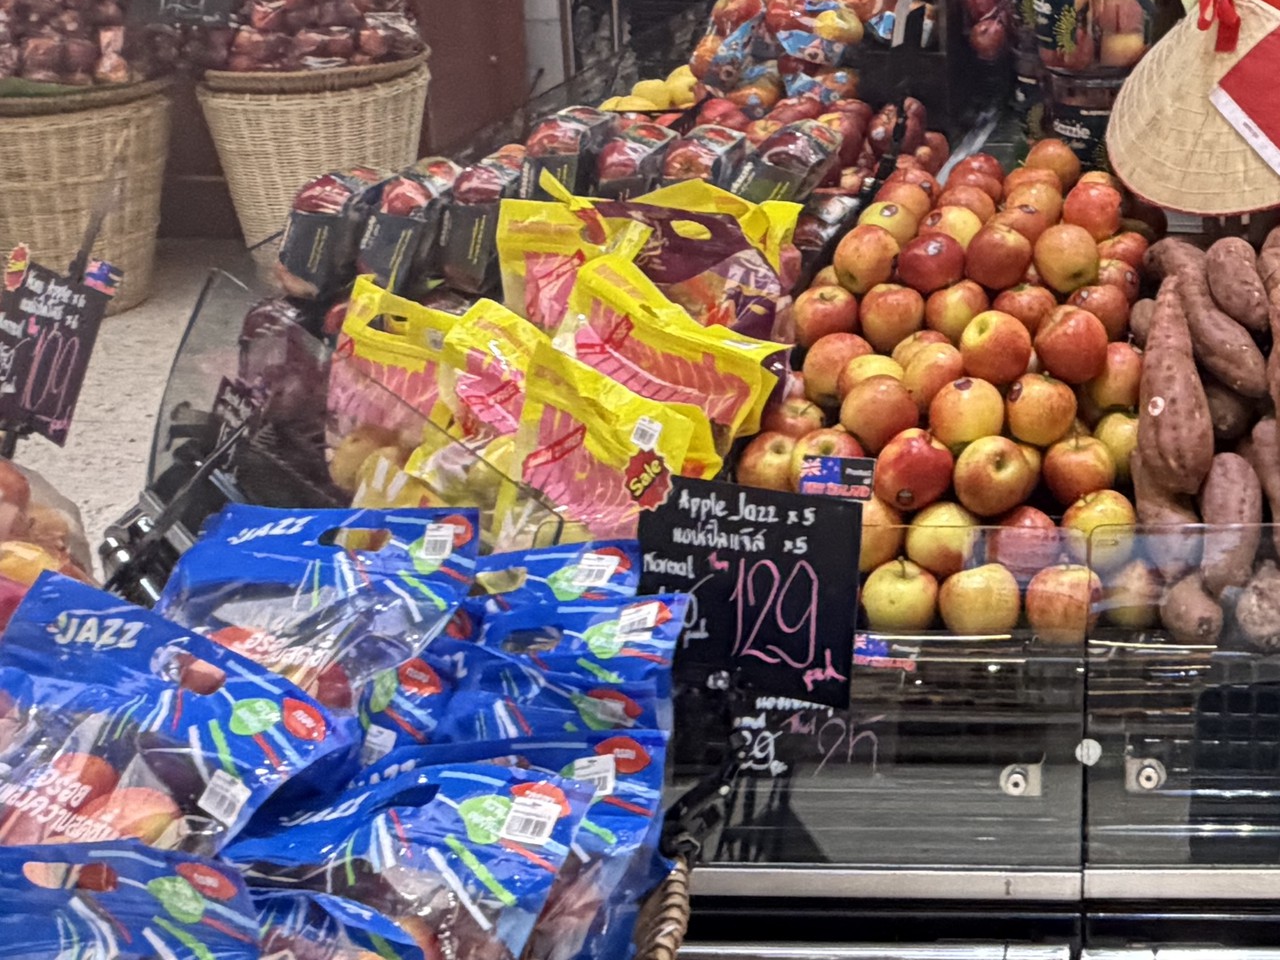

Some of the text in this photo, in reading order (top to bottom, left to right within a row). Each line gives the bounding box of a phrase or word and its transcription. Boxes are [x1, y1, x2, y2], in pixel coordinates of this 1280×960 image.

[629, 459, 662, 497] Sale
[679, 489, 729, 520] Apple
[727, 492, 779, 523] Jazz
[729, 557, 819, 669] 129
[54, 616, 145, 651] JAZZ
